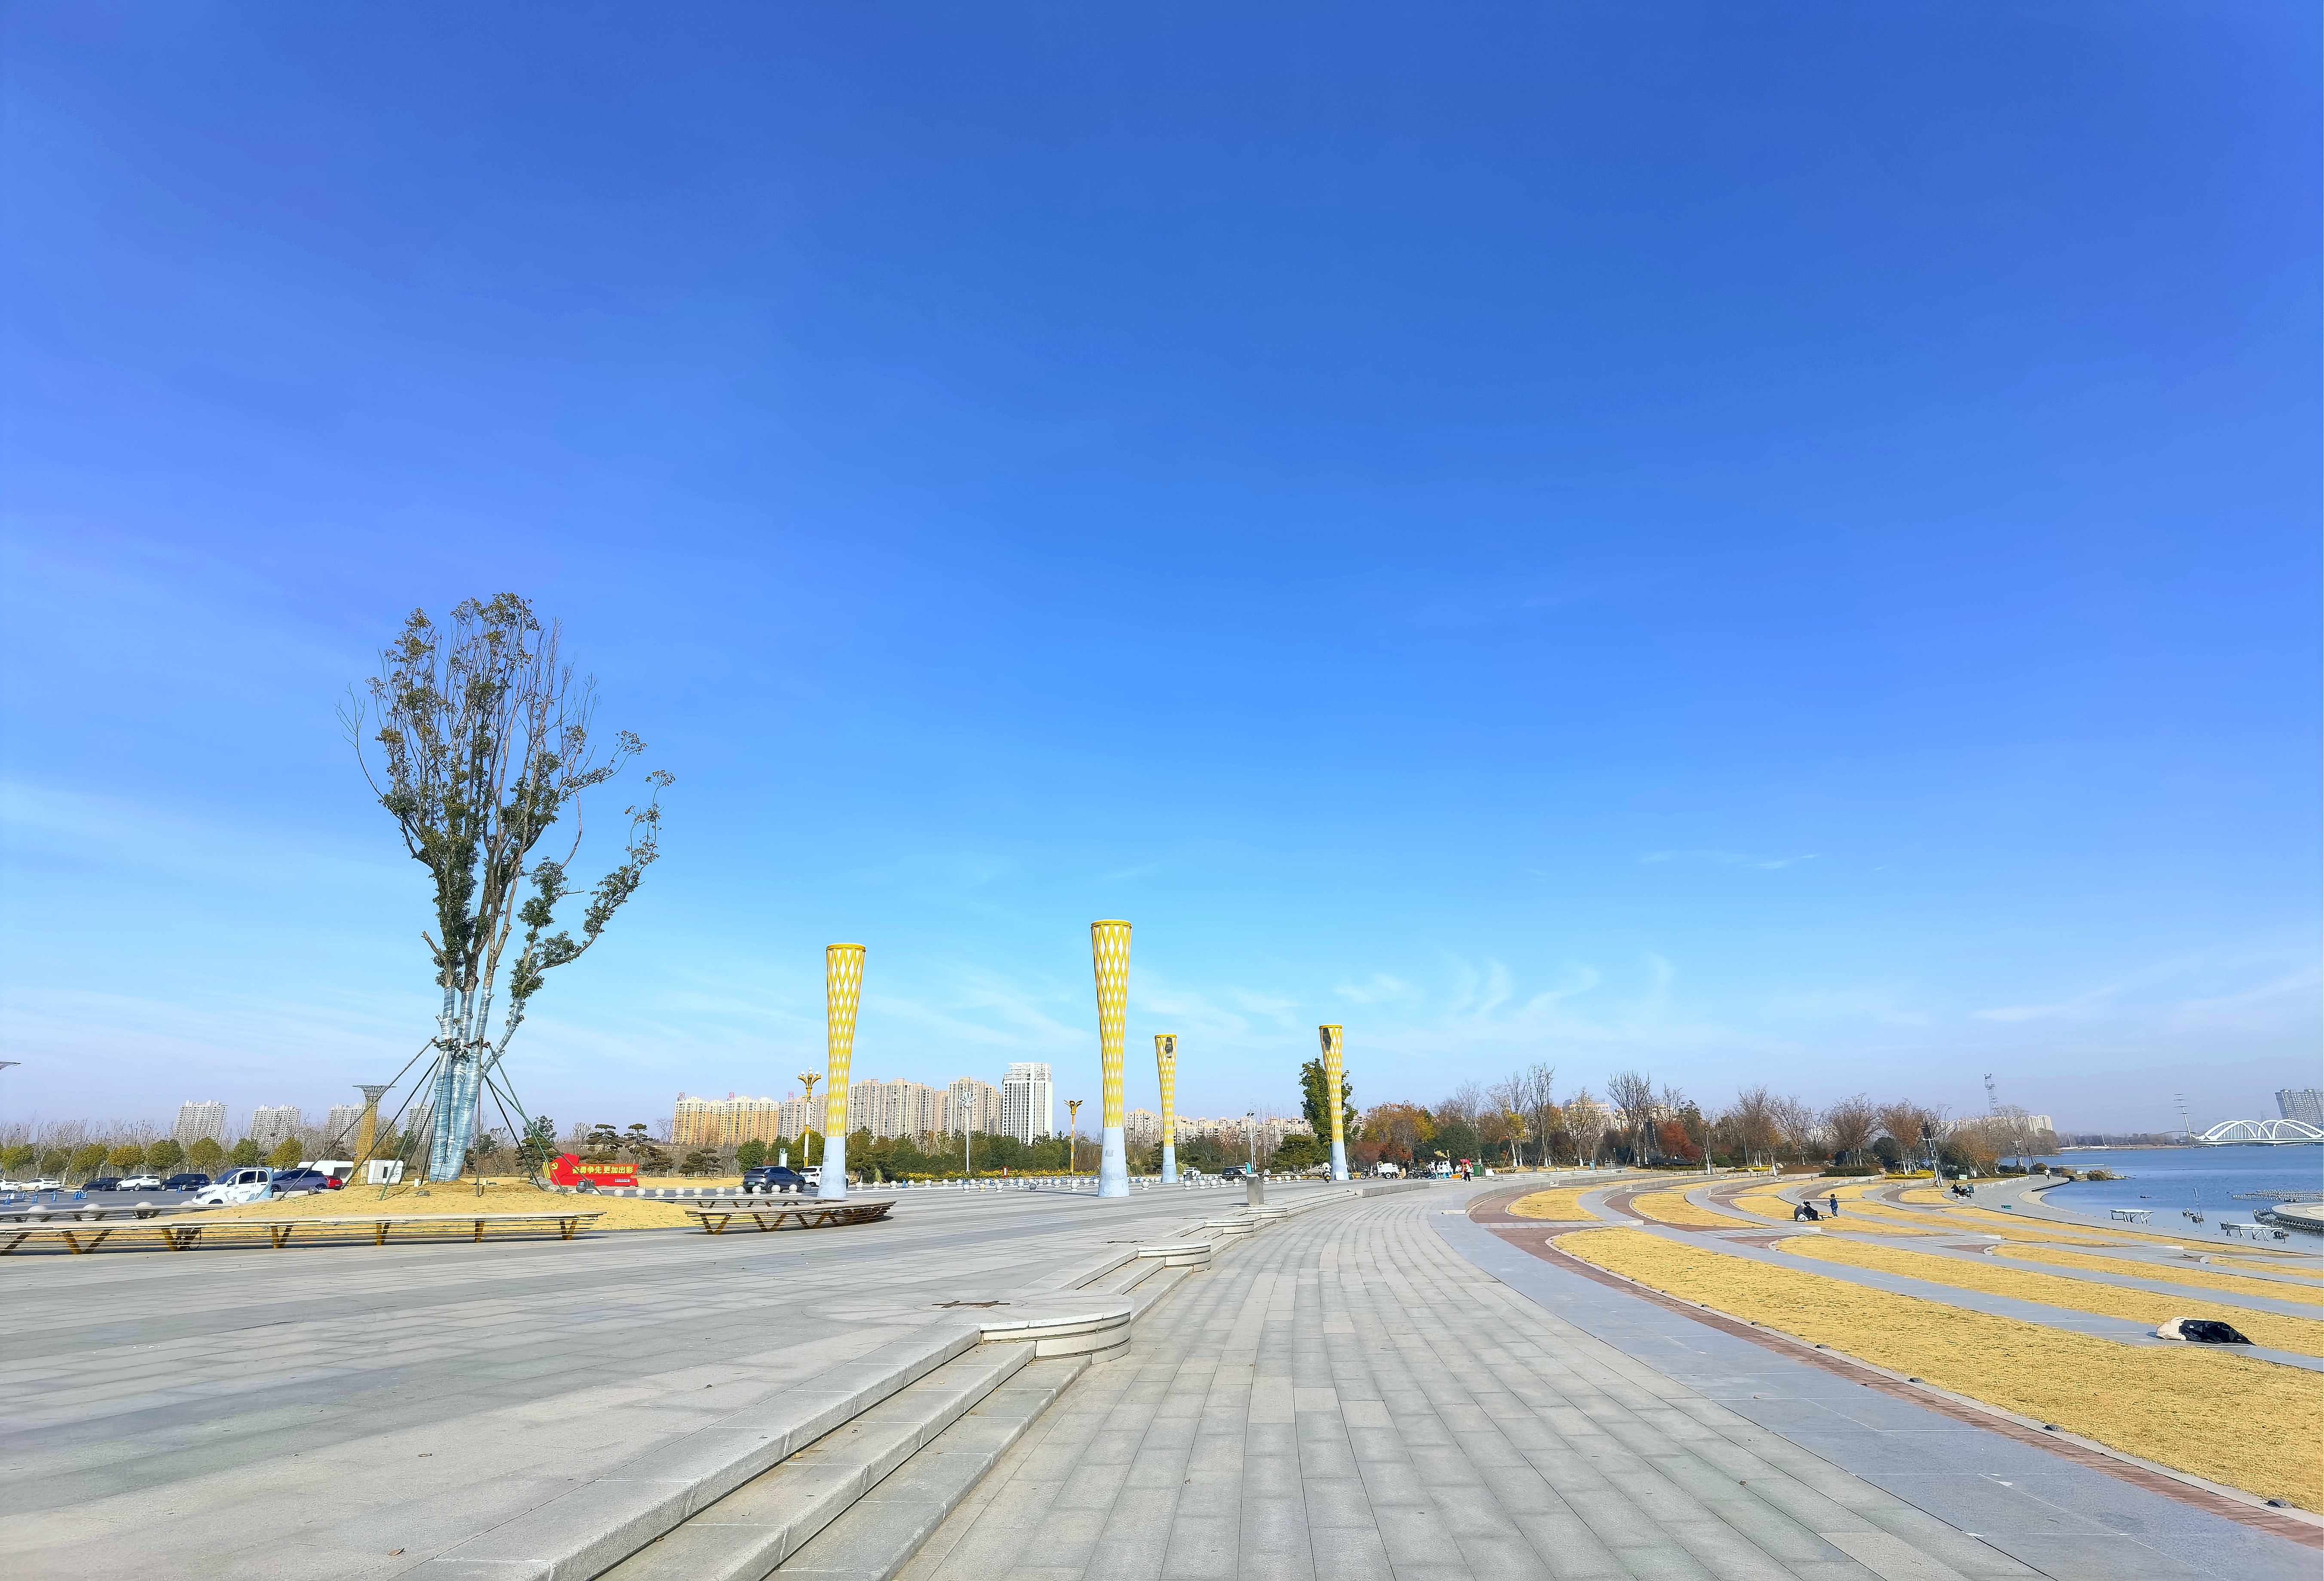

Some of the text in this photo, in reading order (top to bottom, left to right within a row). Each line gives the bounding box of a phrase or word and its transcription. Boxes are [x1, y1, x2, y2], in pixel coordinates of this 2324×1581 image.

[572, 1166, 633, 1174] 奋勇争先 更加出彩
